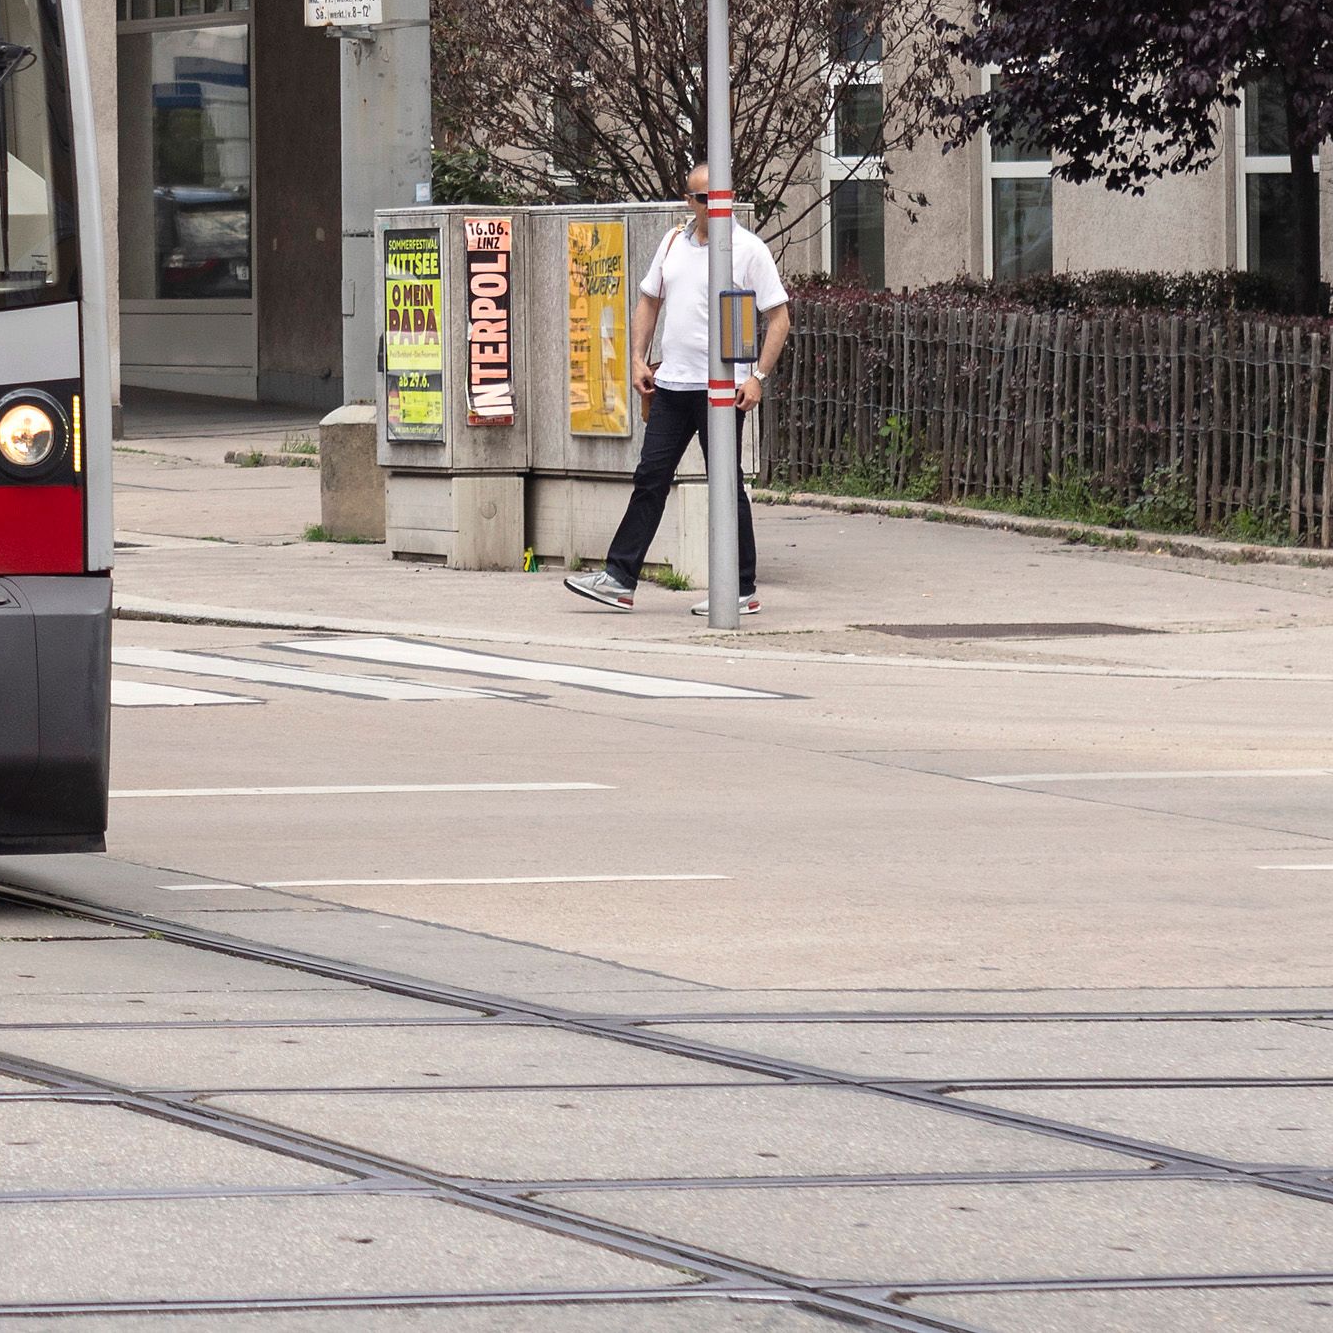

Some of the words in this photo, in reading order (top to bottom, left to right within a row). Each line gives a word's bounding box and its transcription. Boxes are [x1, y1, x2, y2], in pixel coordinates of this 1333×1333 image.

[468, 222, 509, 235] 16.06.
[388, 238, 438, 250] SOMMERFESTIVAL
[476, 237, 500, 249] LINZ
[388, 252, 439, 275] KITTSEE
[392, 284, 401, 307] O
[403, 284, 434, 307] MEIN
[388, 309, 440, 345] PAPA
[470, 253, 514, 416] INTERPOL
[398, 372, 409, 387] ab
[409, 372, 430, 388] 29.6.
